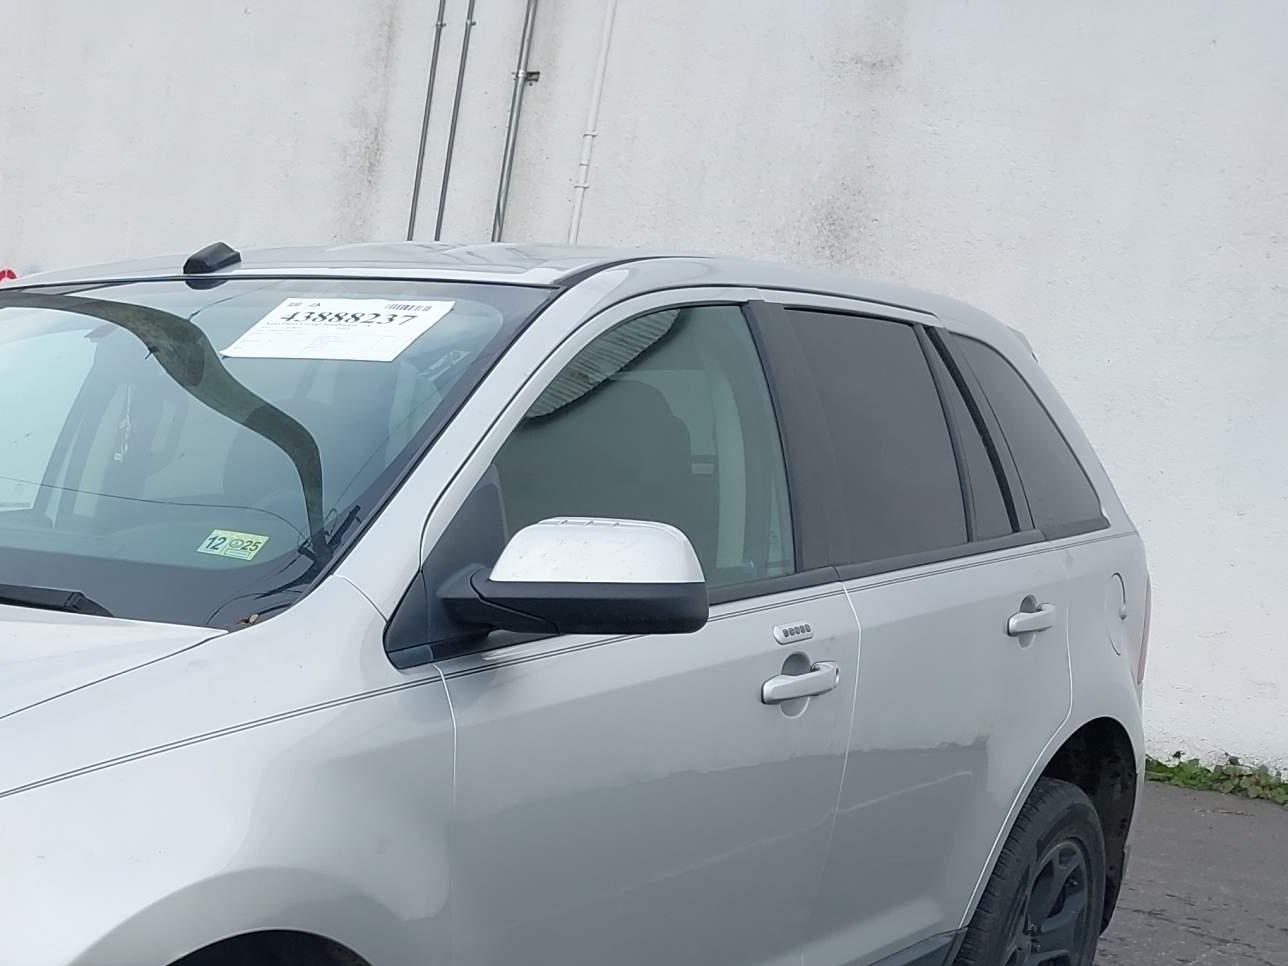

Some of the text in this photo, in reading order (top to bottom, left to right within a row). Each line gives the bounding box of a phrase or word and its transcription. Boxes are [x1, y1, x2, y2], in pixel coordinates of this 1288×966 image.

[281, 311, 418, 326] 43888237
[206, 536, 261, 552] 12 25
